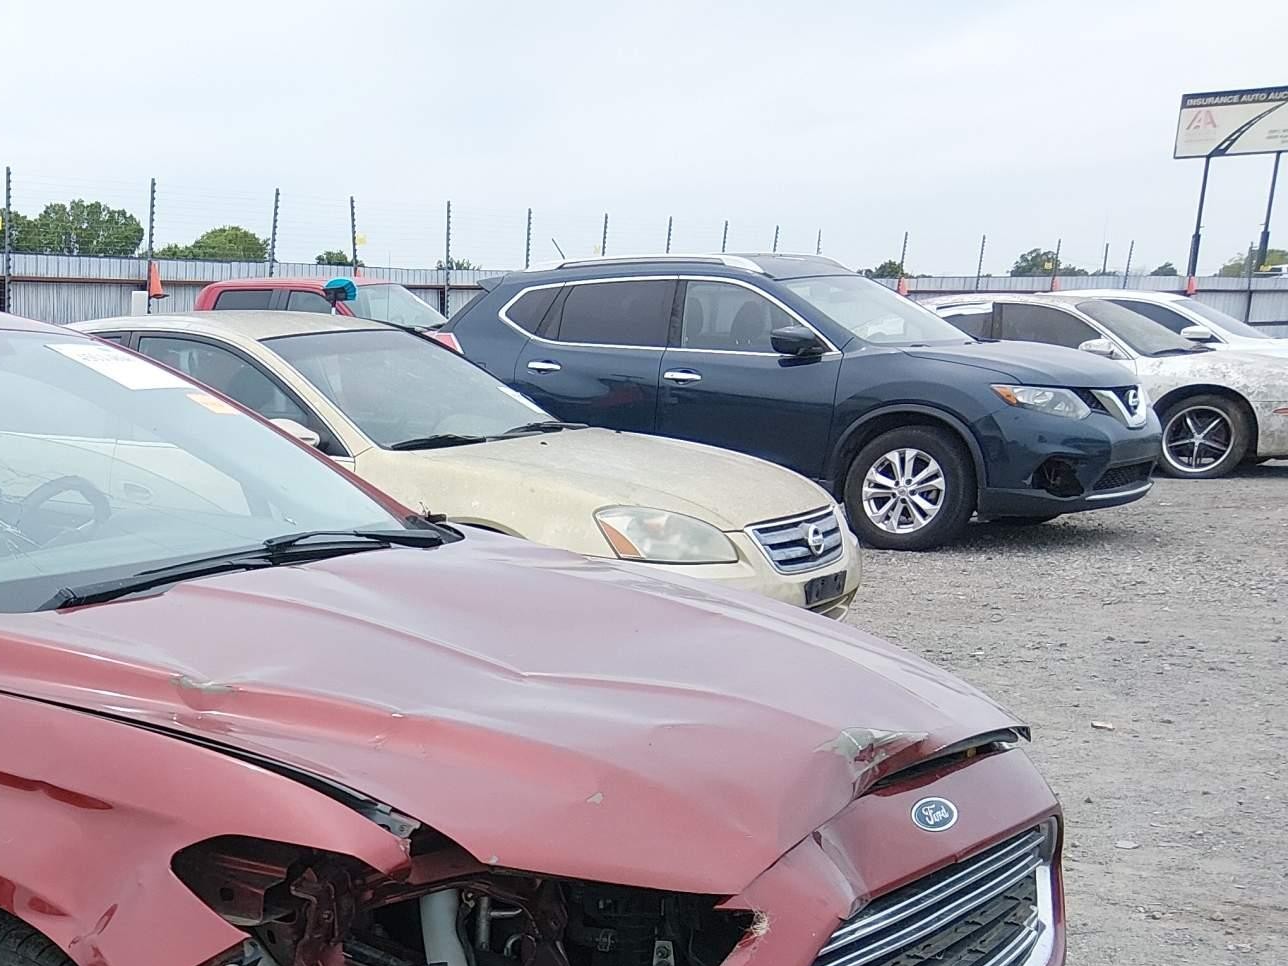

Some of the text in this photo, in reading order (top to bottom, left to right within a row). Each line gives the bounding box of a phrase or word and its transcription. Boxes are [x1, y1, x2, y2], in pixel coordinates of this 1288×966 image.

[1187, 94, 1240, 106] INSURANCE
[1240, 93, 1267, 102] AUTO
[922, 804, 949, 825] Ford
